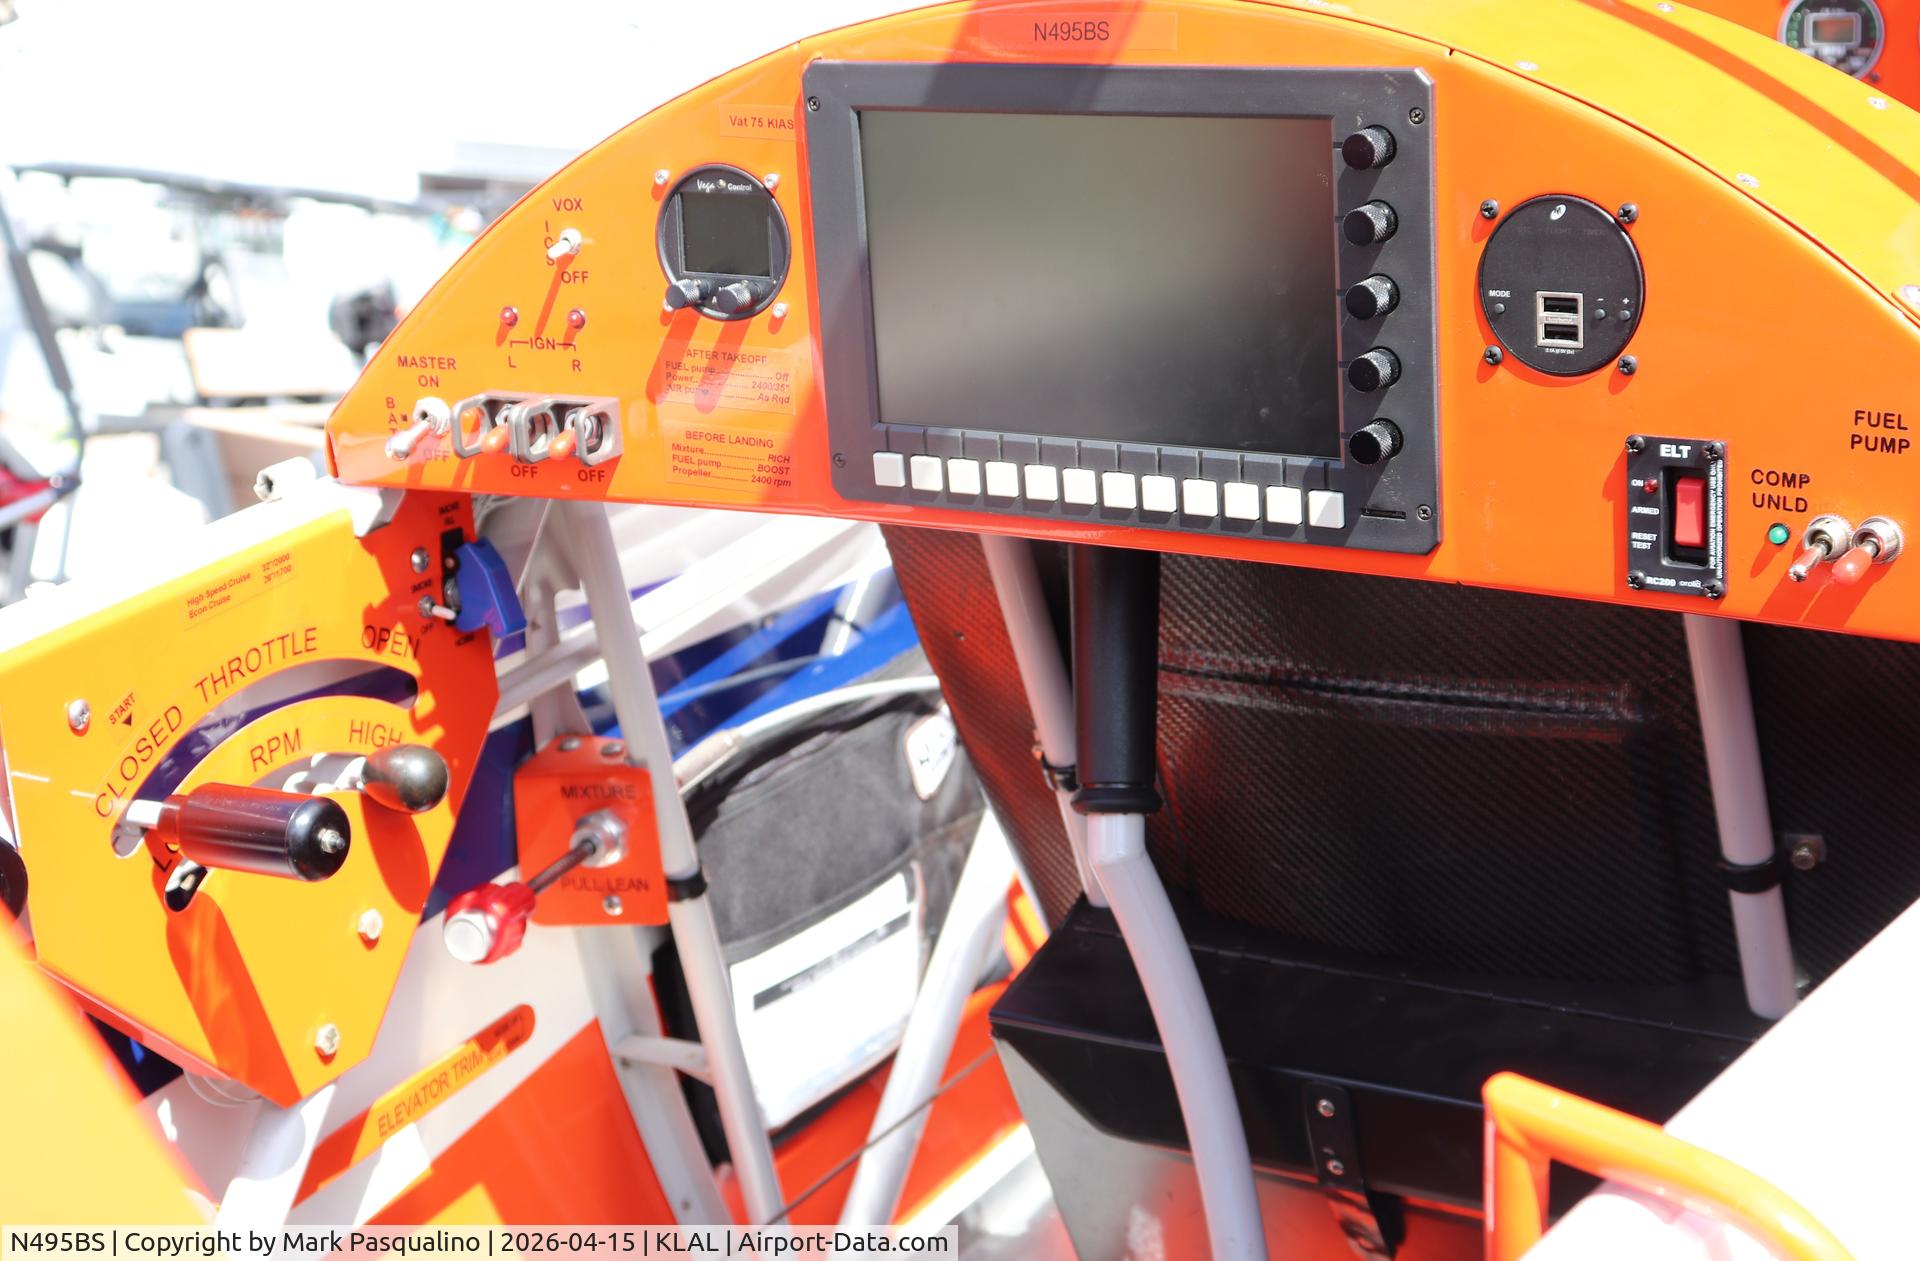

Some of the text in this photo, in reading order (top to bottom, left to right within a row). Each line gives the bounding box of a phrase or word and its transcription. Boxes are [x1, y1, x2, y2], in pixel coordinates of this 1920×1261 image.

[1033, 20, 1110, 42] N495BS
[751, 116, 764, 128] 75
[767, 118, 794, 130] KIAS
[696, 178, 752, 194] Vega Control
[552, 198, 583, 212] VOX
[560, 270, 589, 284] OFF
[1488, 289, 1511, 298] MODE
[530, 336, 556, 350] IGN
[397, 355, 457, 370] MASTER
[508, 355, 582, 372] L R
[686, 349, 768, 364] AFTER TAKEOFF
[665, 360, 689, 372] FUEL
[775, 372, 789, 381] Off
[665, 372, 693, 383] Power
[417, 374, 440, 388] ON
[757, 393, 769, 402] As
[771, 394, 790, 404] Rqd
[1853, 409, 1909, 431] FUEL
[685, 430, 774, 449] BEFORE LANDING
[1850, 434, 1910, 454] PUMP
[423, 449, 450, 463] OFF
[671, 443, 791, 464] Mixture RICH
[1659, 443, 1692, 459] ELT
[510, 464, 539, 478] OFF
[671, 454, 790, 475] FUEL pump BOOST
[577, 469, 606, 483] OFF
[672, 465, 792, 488] Propeller 2400 rpm
[1631, 479, 1644, 487] ON
[1751, 469, 1811, 489] COMP
[1752, 492, 1808, 513] UNLD
[1631, 506, 1660, 516] ARMED
[1716, 497, 1724, 531] OPERATION
[1631, 532, 1658, 541] RESET
[1631, 541, 1652, 550] TEST
[186, 593, 204, 607] High
[205, 582, 228, 599] Speed
[228, 572, 252, 588] Cruise
[1645, 576, 1677, 587] RC200
[188, 604, 208, 619] Econ
[208, 594, 231, 610] Cruise
[109, 691, 137, 726] START
[95, 624, 422, 819] CLOSED THROTTLE OPEN
[249, 727, 302, 773] RPM
[560, 783, 638, 801] MIXTURE
[560, 875, 649, 894] PULL LEAN
[377, 1048, 485, 1138] ELEVATOR TRIM
